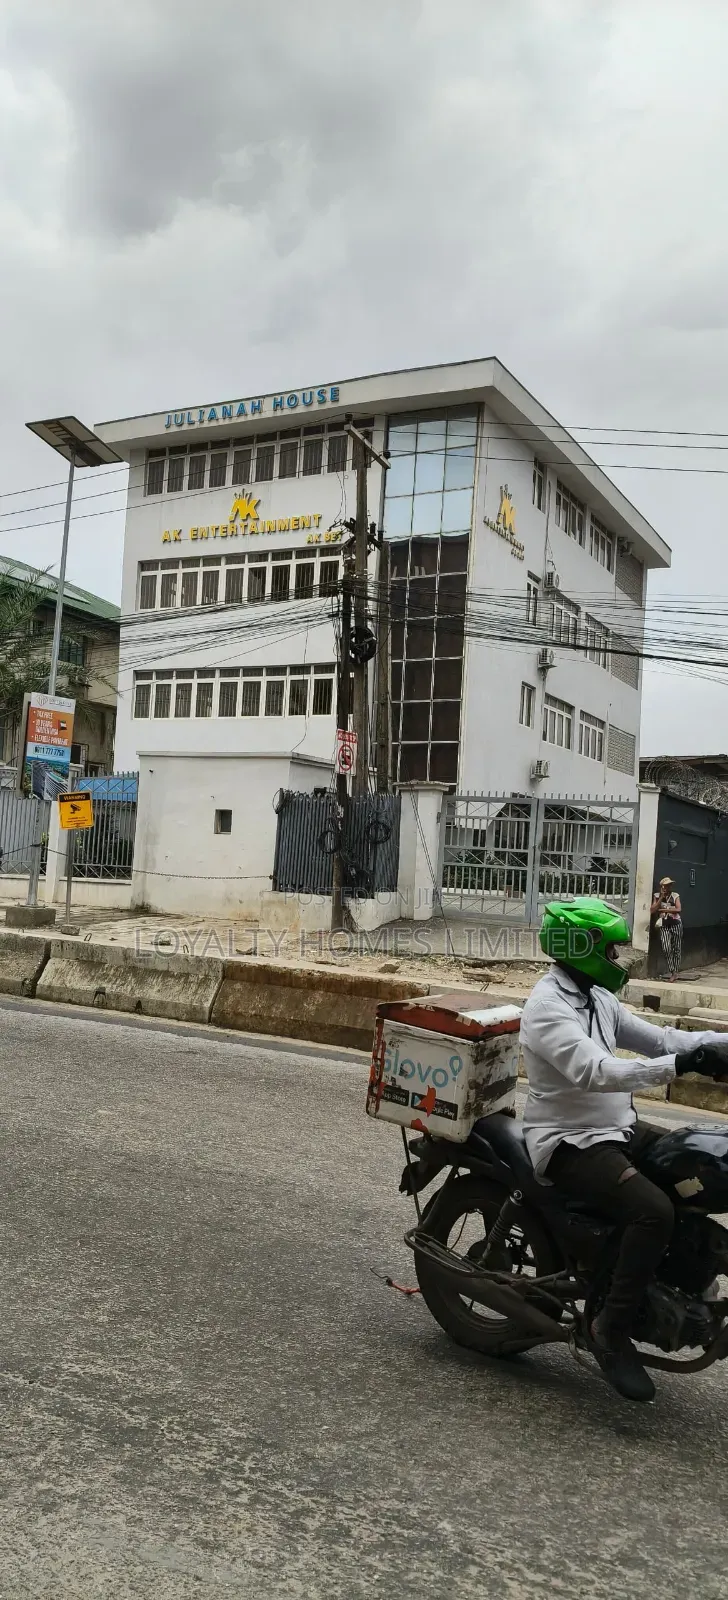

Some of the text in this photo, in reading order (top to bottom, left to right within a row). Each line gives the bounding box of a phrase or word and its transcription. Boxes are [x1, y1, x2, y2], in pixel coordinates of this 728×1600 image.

[165, 387, 340, 428] JULIANAH HOUSE
[162, 513, 322, 543] AK ENTERTAINMENT
